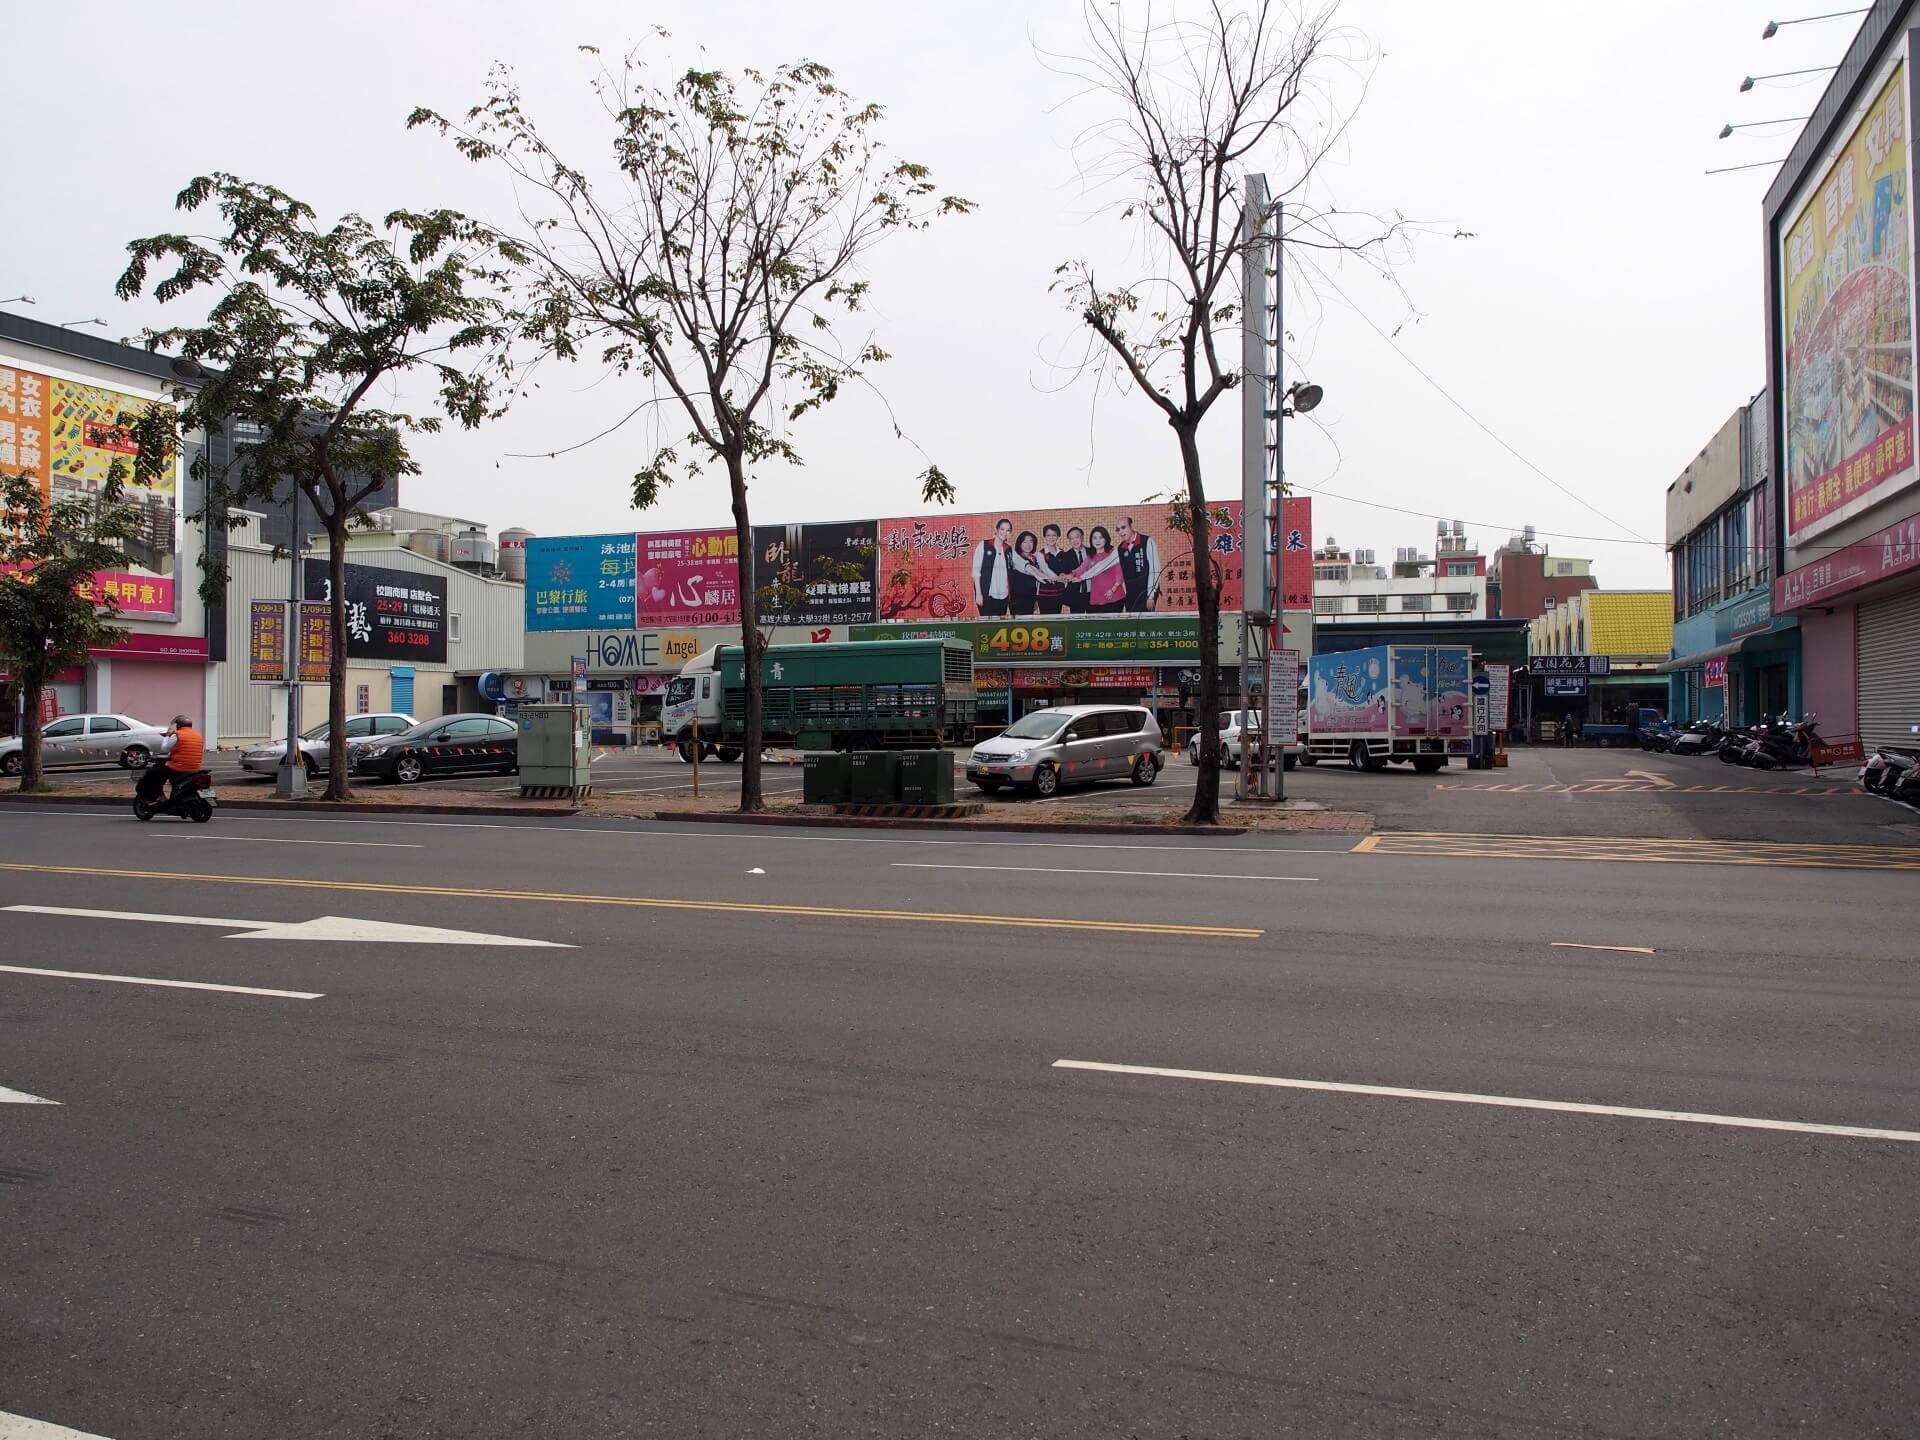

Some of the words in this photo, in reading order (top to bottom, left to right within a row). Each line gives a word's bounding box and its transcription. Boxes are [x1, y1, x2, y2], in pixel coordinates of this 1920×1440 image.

[1824, 155, 1854, 239] 百貨
[885, 522, 969, 559] 新年快樂
[536, 589, 587, 605] 巴黎行旅
[833, 613, 872, 622] 591-2577
[388, 632, 405, 643] 360
[990, 627, 1050, 652] 498
[586, 634, 659, 667] HOME
[666, 639, 698, 657] Angel
